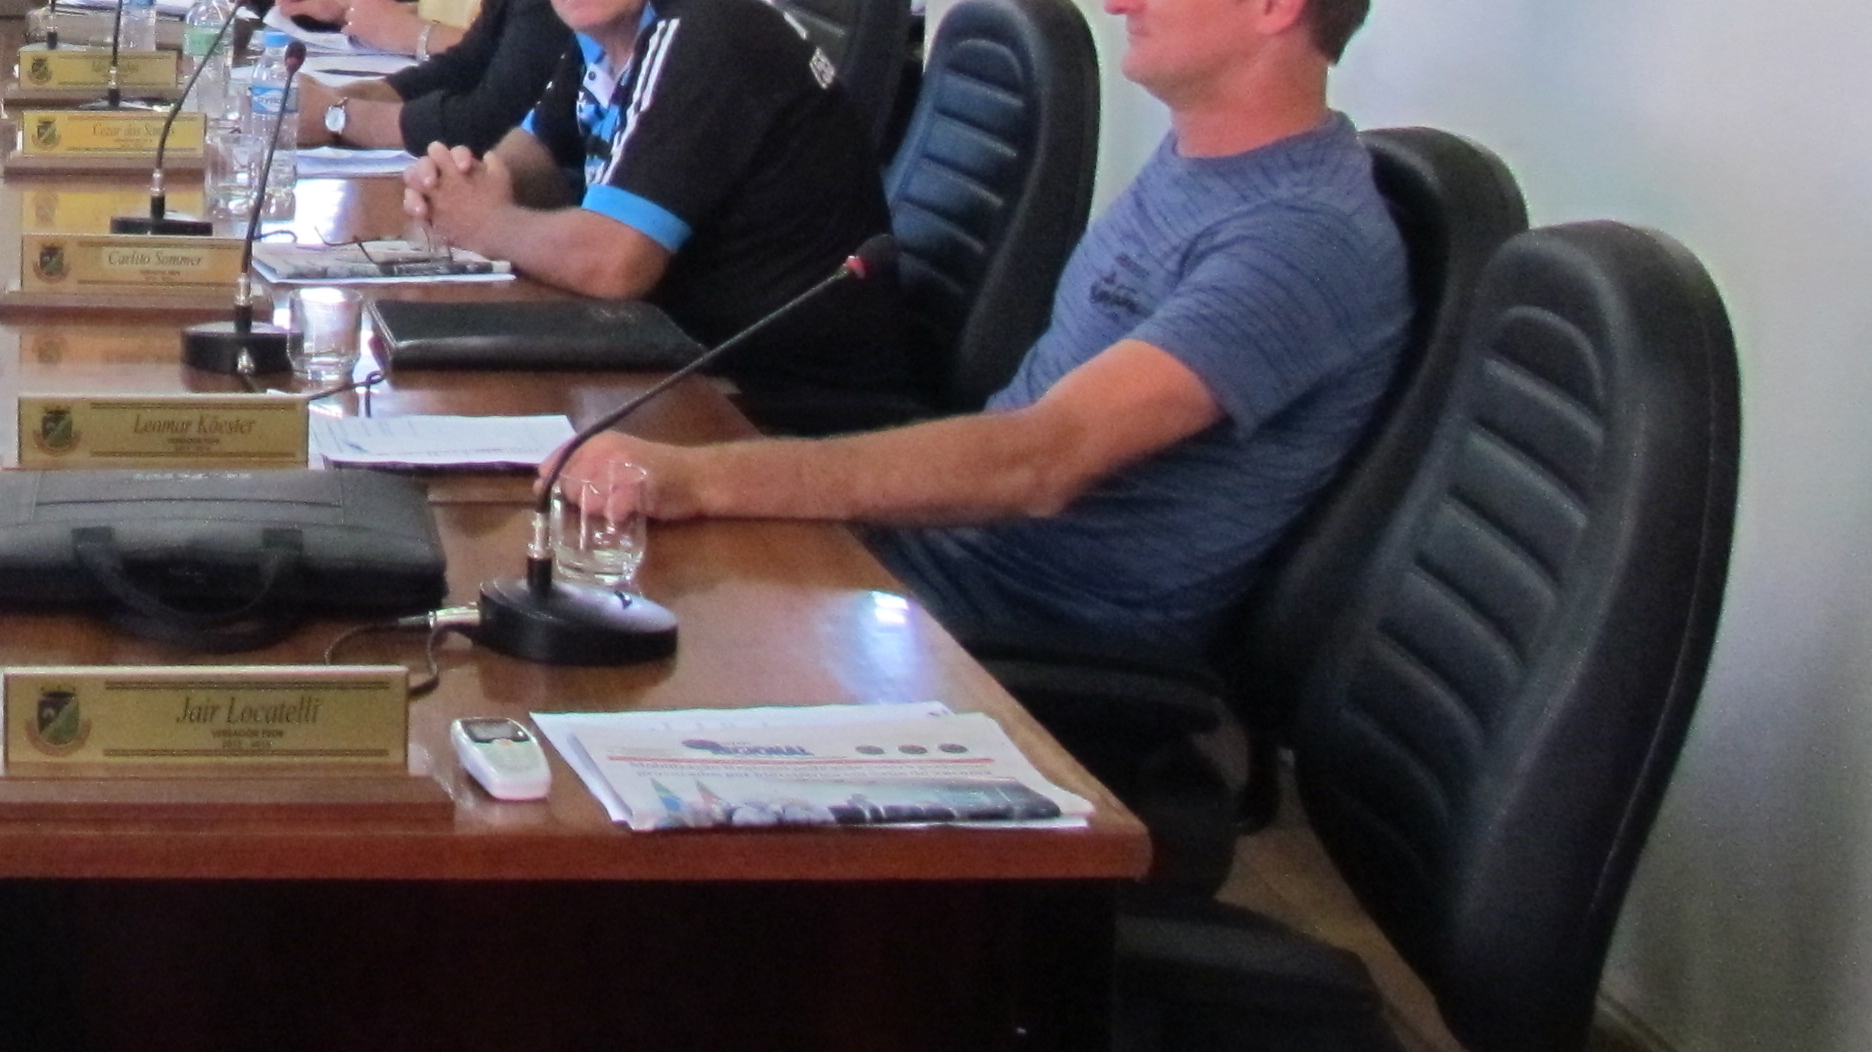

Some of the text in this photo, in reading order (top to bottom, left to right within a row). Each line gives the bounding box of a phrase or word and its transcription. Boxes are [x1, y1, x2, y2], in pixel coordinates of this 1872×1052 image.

[155, 250, 202, 267] Sommer
[175, 695, 322, 724] Jair Locatelli
